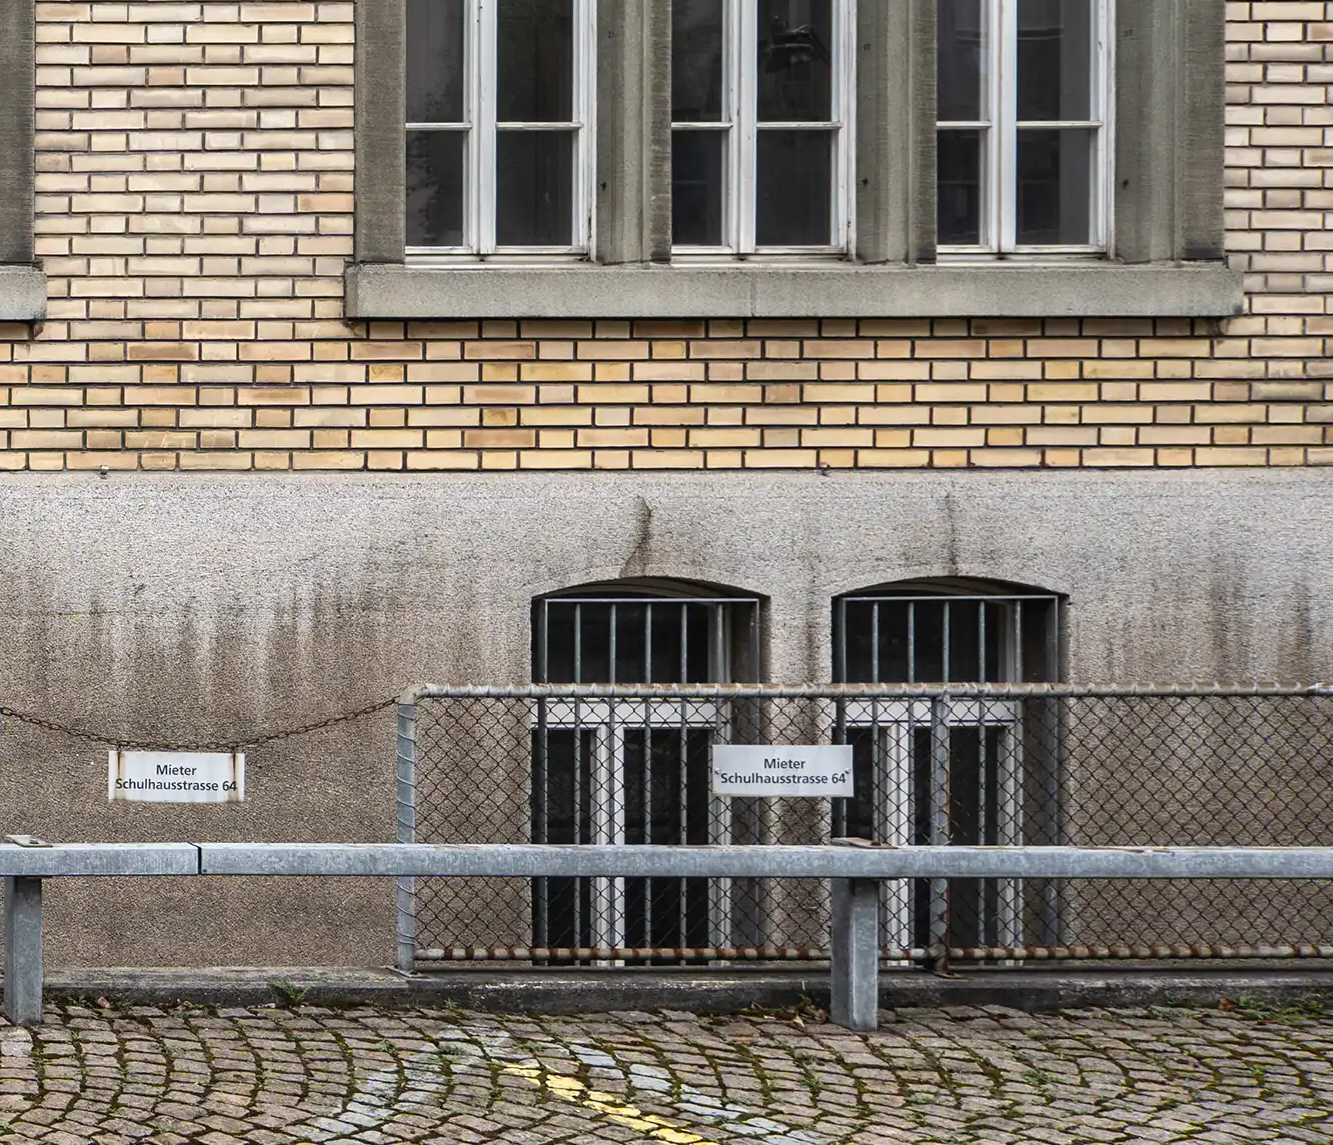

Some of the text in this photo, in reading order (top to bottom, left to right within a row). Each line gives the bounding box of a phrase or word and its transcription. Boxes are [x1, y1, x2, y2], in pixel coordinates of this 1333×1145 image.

[763, 758, 806, 769] Mieter
[156, 764, 197, 776] Mieter
[720, 772, 846, 784] Schulhausstrasse 64
[115, 778, 237, 792] Schulhausstrasse 64
